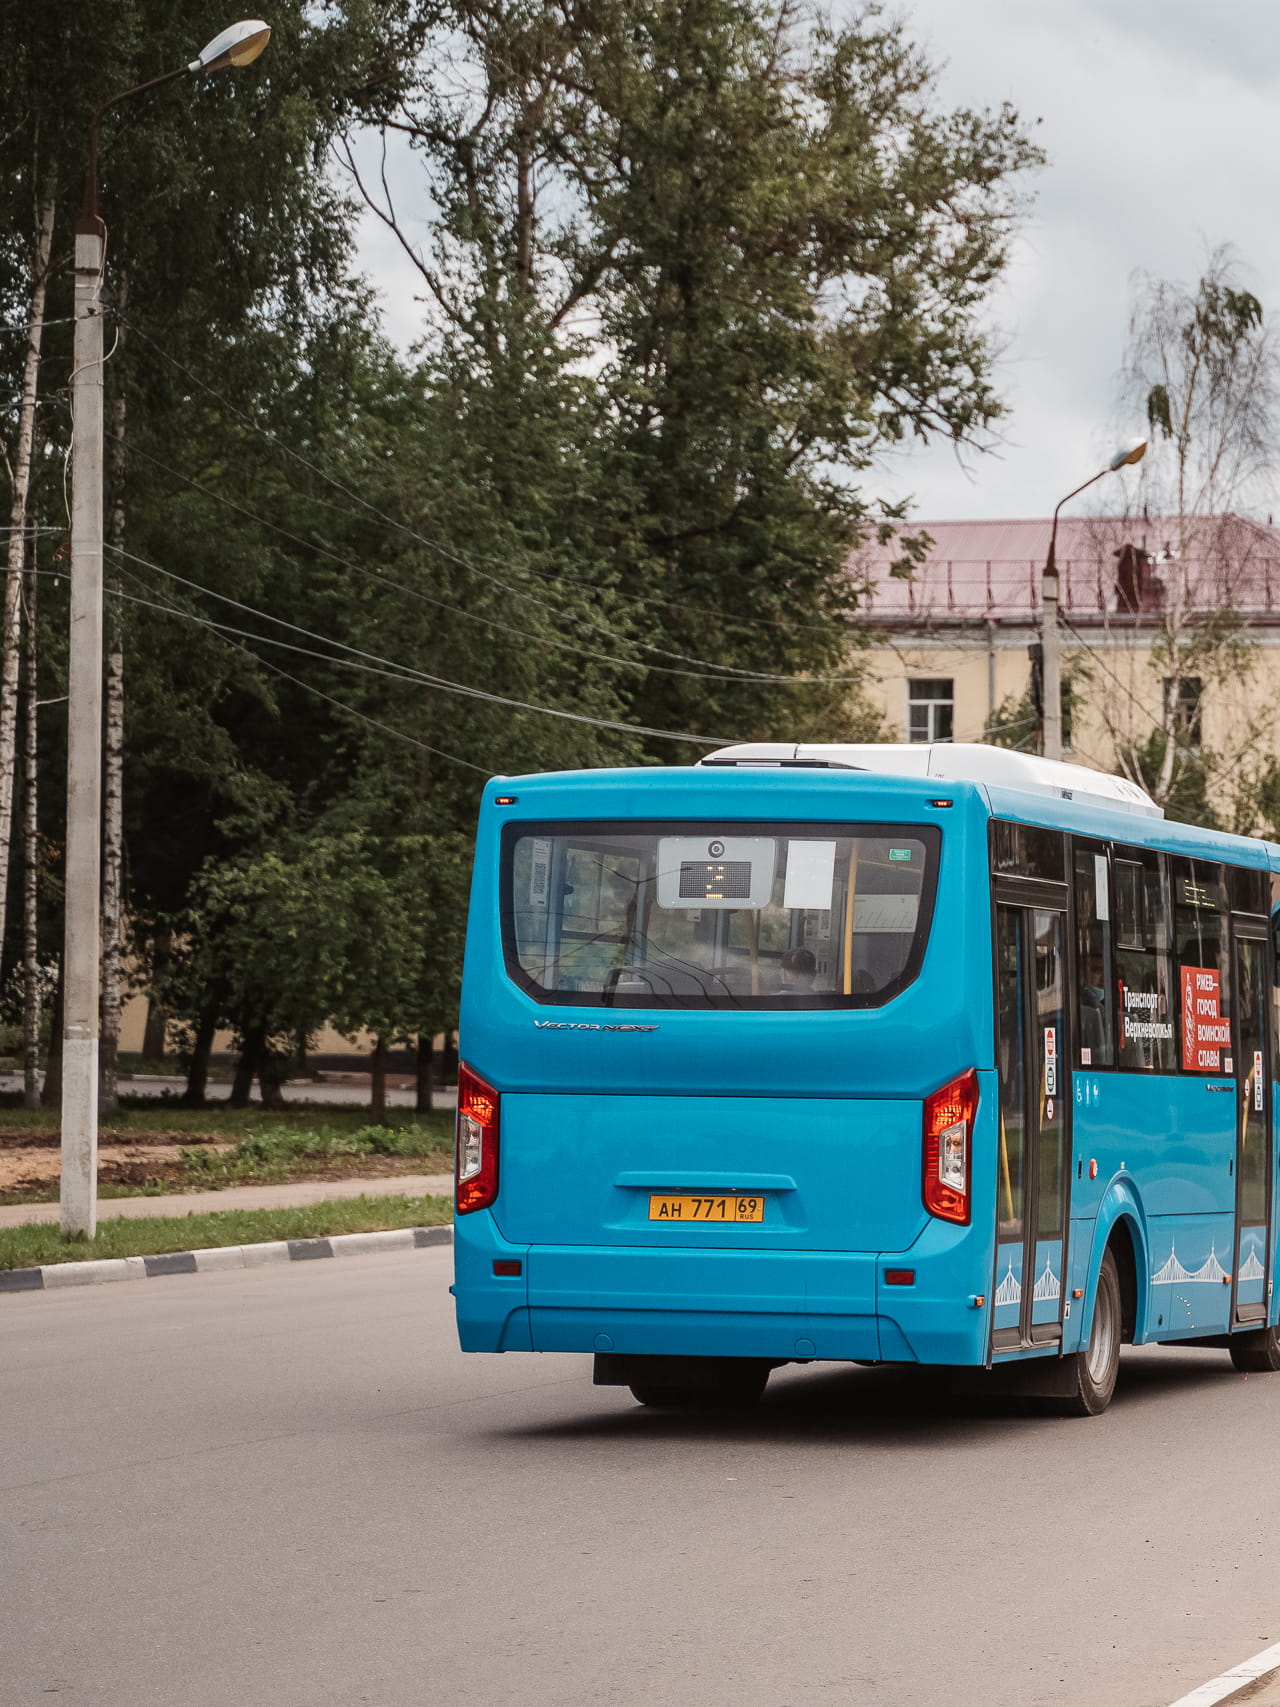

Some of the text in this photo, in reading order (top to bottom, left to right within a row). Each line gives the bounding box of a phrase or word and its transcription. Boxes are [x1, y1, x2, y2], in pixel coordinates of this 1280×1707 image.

[1123, 986, 1158, 1013] Транспорт
[1196, 998, 1217, 1019] ГОРОД
[1124, 1016, 1173, 1042] Верхневолжья
[1197, 1022, 1230, 1042] ВОИНСКОЙ
[1198, 1050, 1220, 1067] СЛАВЫ
[691, 1199, 726, 1218] 771
[738, 1199, 757, 1213] 69
